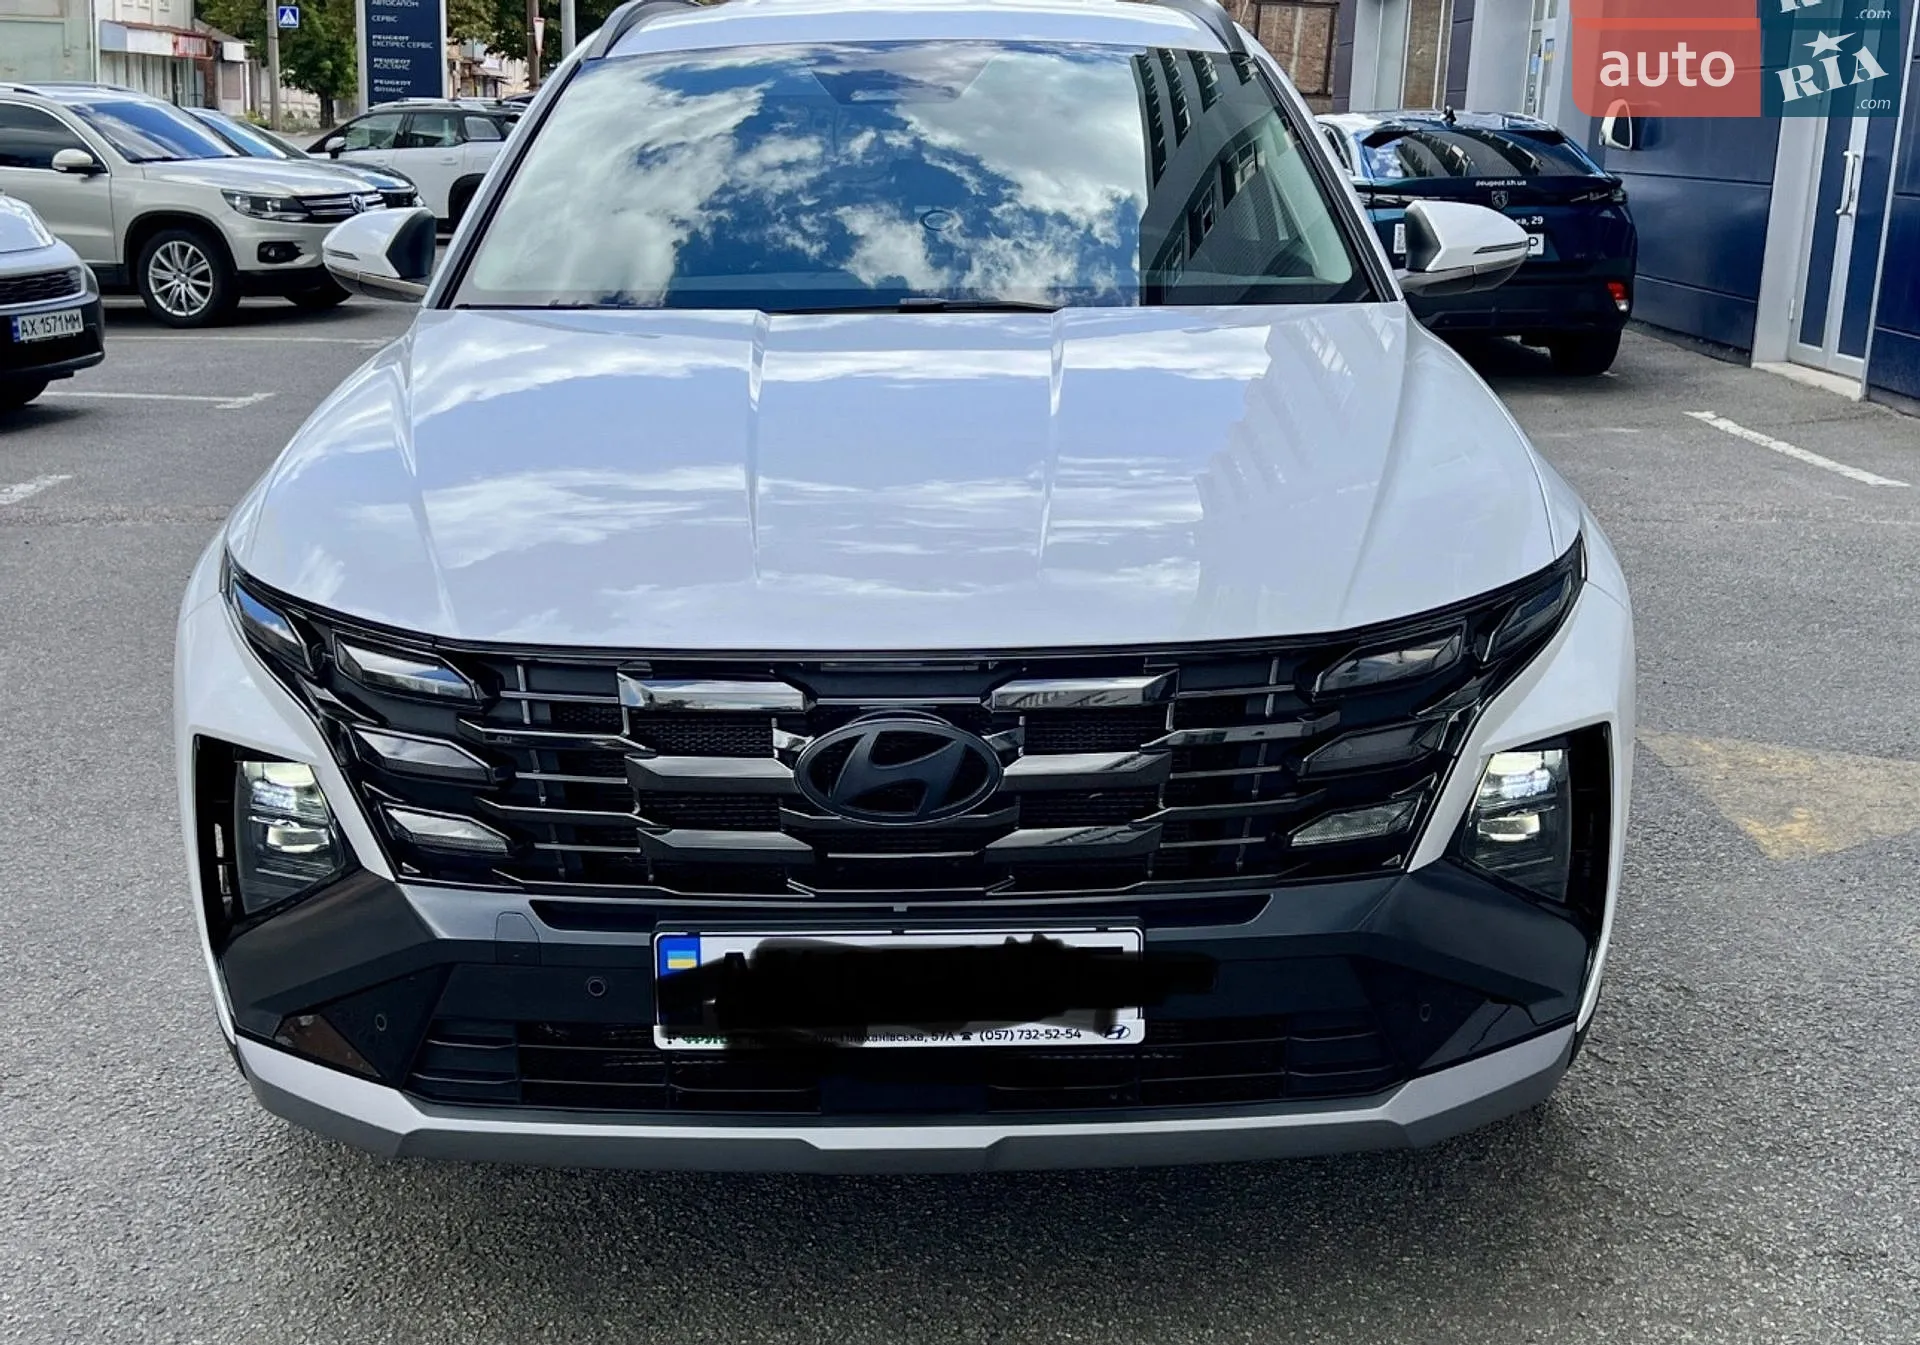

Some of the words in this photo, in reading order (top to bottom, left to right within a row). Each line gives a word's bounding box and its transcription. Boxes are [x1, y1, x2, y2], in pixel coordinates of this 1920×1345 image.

[1531, 215, 1544, 225] 29
[21, 319, 38, 337] AX
[980, 1029, 1014, 1041] (057)
[1017, 1028, 1081, 1040] 732-52-54
